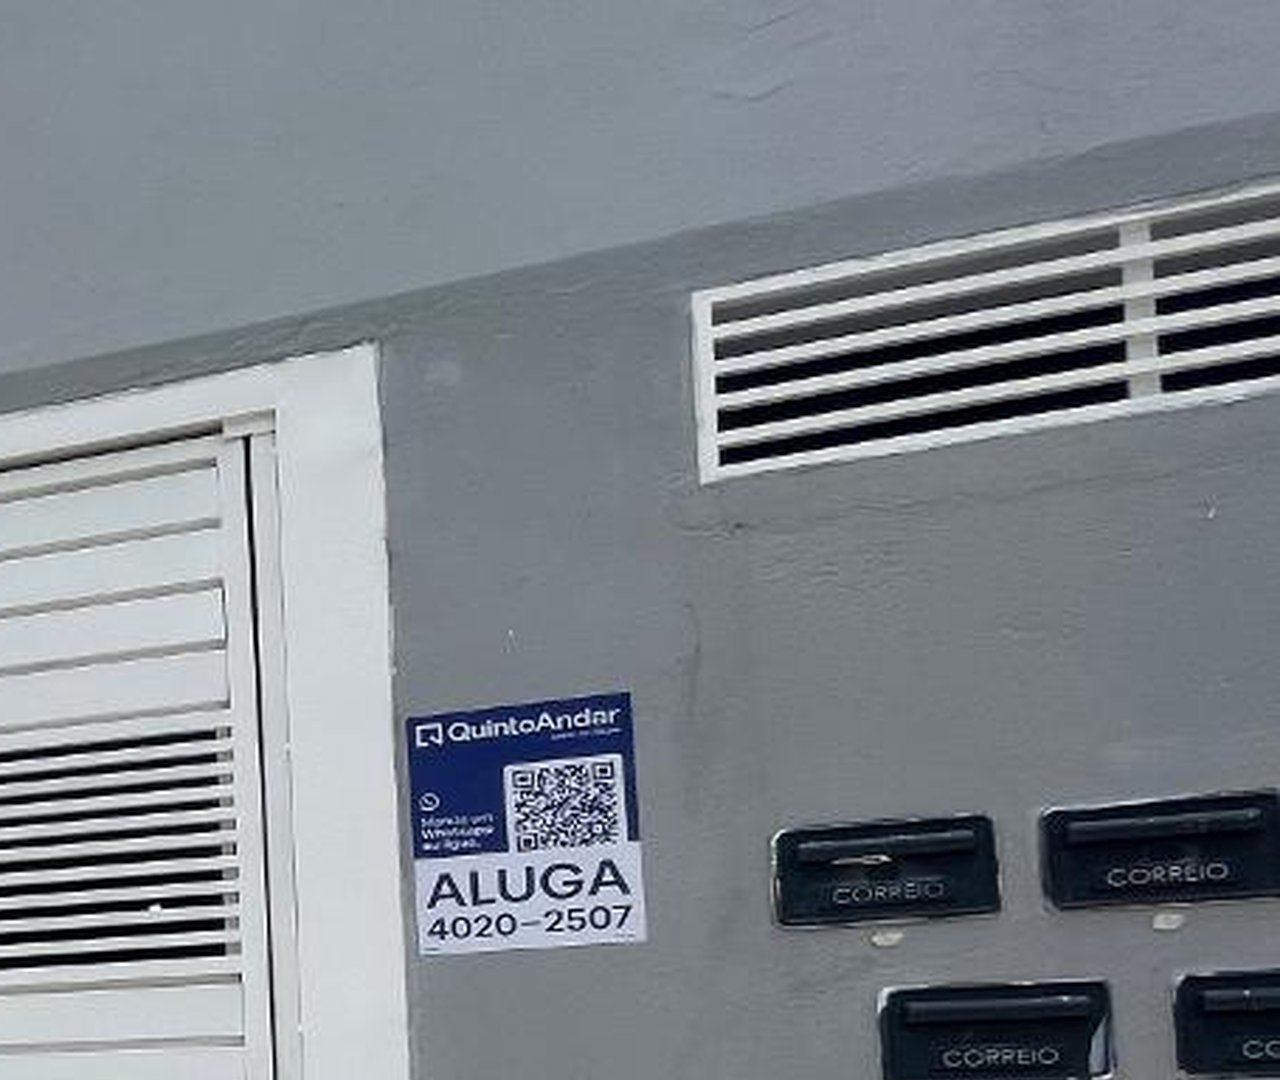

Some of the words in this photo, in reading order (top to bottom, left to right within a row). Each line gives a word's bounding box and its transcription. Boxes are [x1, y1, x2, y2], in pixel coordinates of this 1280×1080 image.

[448, 707, 622, 742] QuintoAndar
[427, 858, 631, 909] ALUGA
[1107, 862, 1229, 887] CORREIO
[832, 881, 944, 904] CORREIO
[427, 904, 633, 940] 4020-2507
[942, 1046, 1059, 1068] CORREIO
